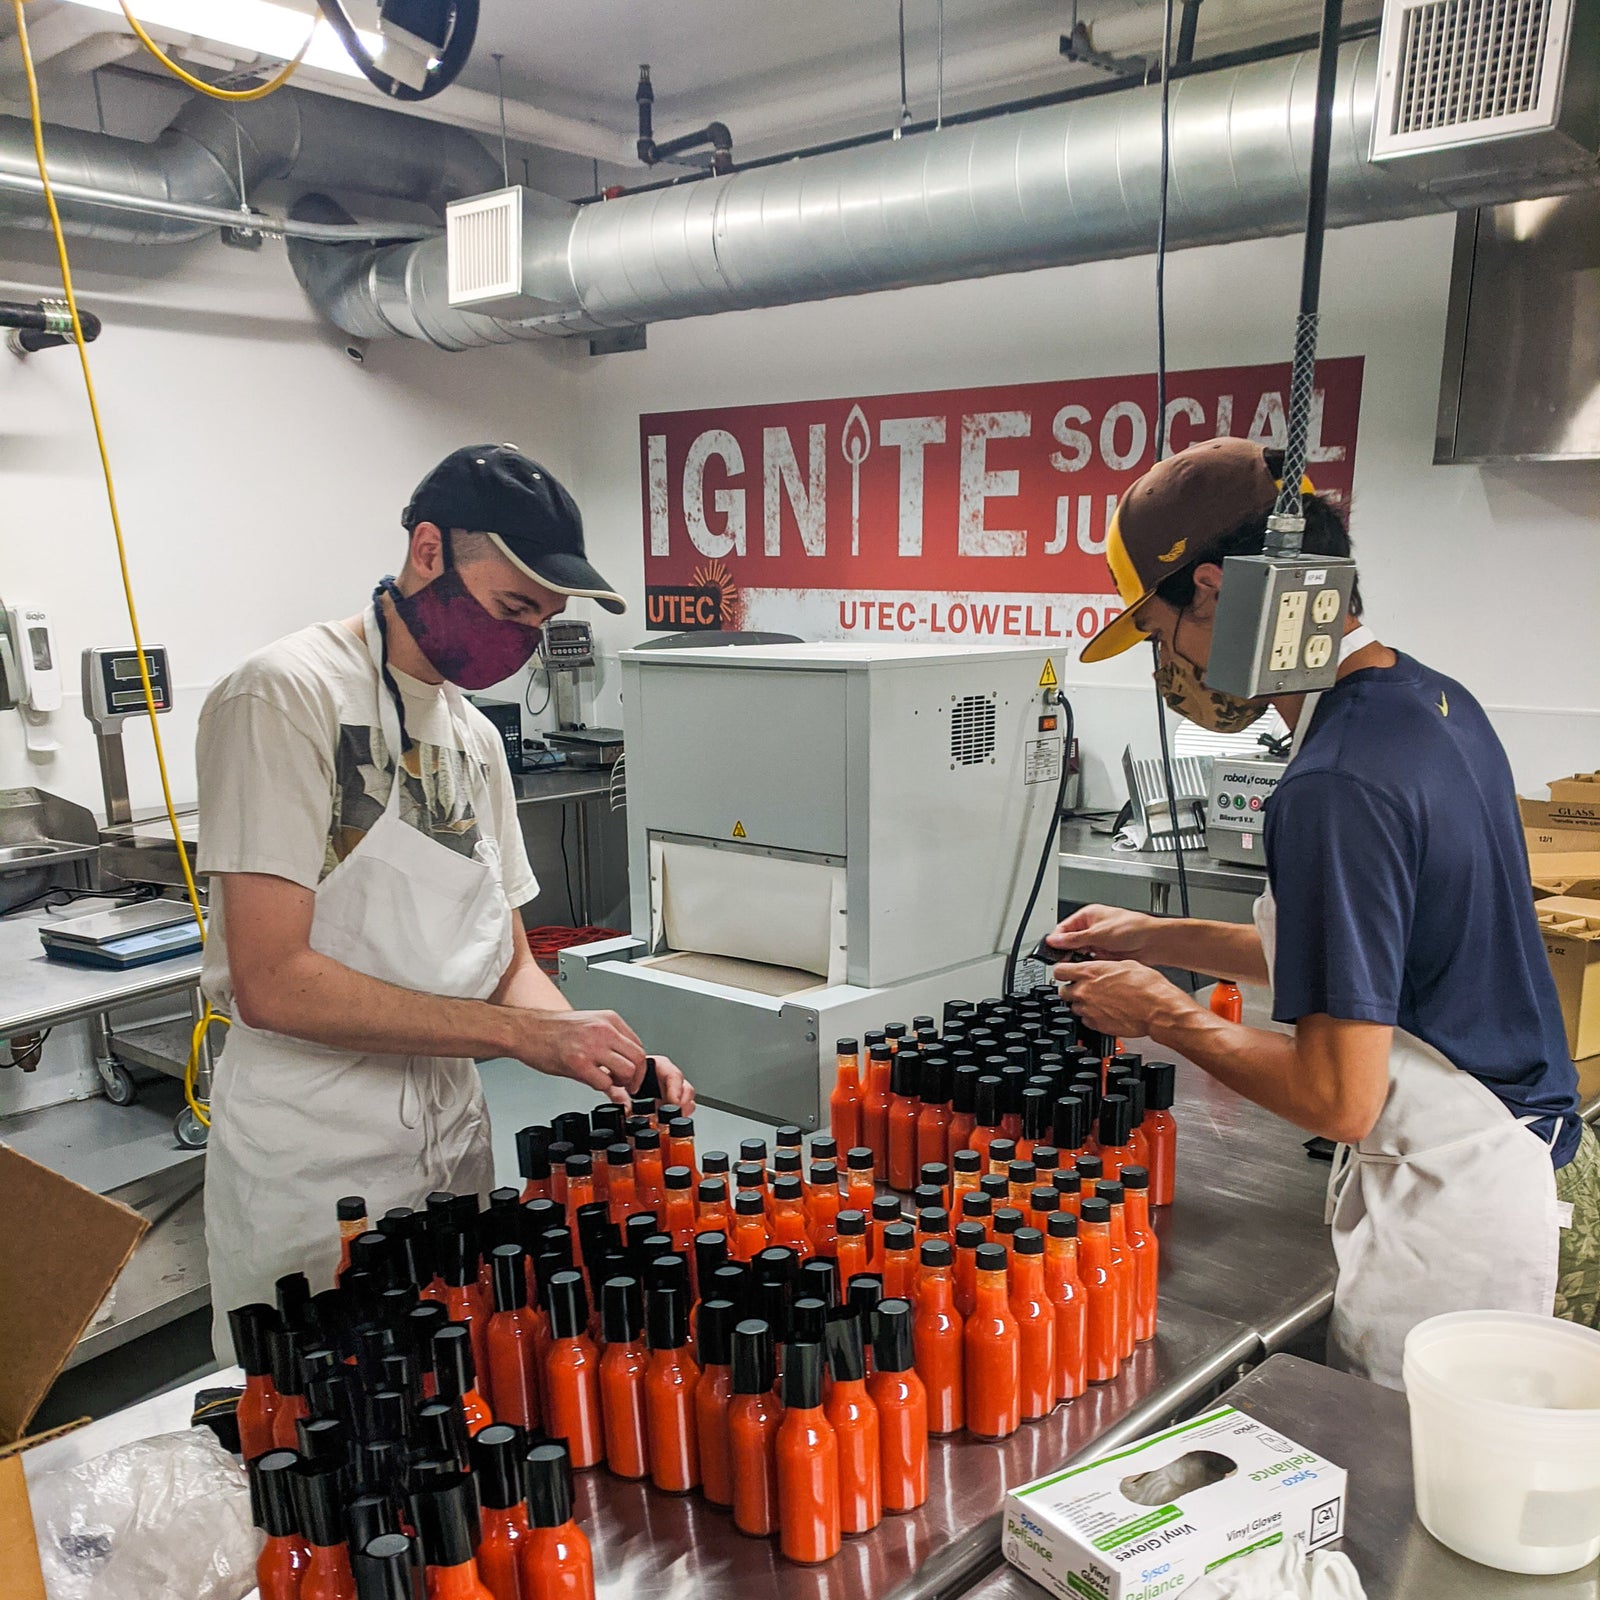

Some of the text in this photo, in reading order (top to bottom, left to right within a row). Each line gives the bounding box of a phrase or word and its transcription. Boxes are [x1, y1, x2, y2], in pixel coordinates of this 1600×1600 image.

[1049, 387, 1347, 473] SOCIAL
[648, 594, 715, 625] UTEC
[1223, 773, 1247, 783] robot
[1558, 807, 1595, 817] GLASS
[1248, 1452, 1317, 1482] Reliance
[1281, 1469, 1319, 1487] Sysco
[1020, 1513, 1043, 1537] Sysco
[1159, 1523, 1198, 1545] Vinyl
[1225, 1523, 1251, 1541] Vinyl
[1251, 1511, 1283, 1531] Gloves
[1007, 1518, 1054, 1562] Reliance
[1114, 1538, 1162, 1562] Gloves
[1080, 1569, 1110, 1596] Gloves
[1088, 1562, 1111, 1585] Vinyl
[1141, 1562, 1171, 1583] Sysco
